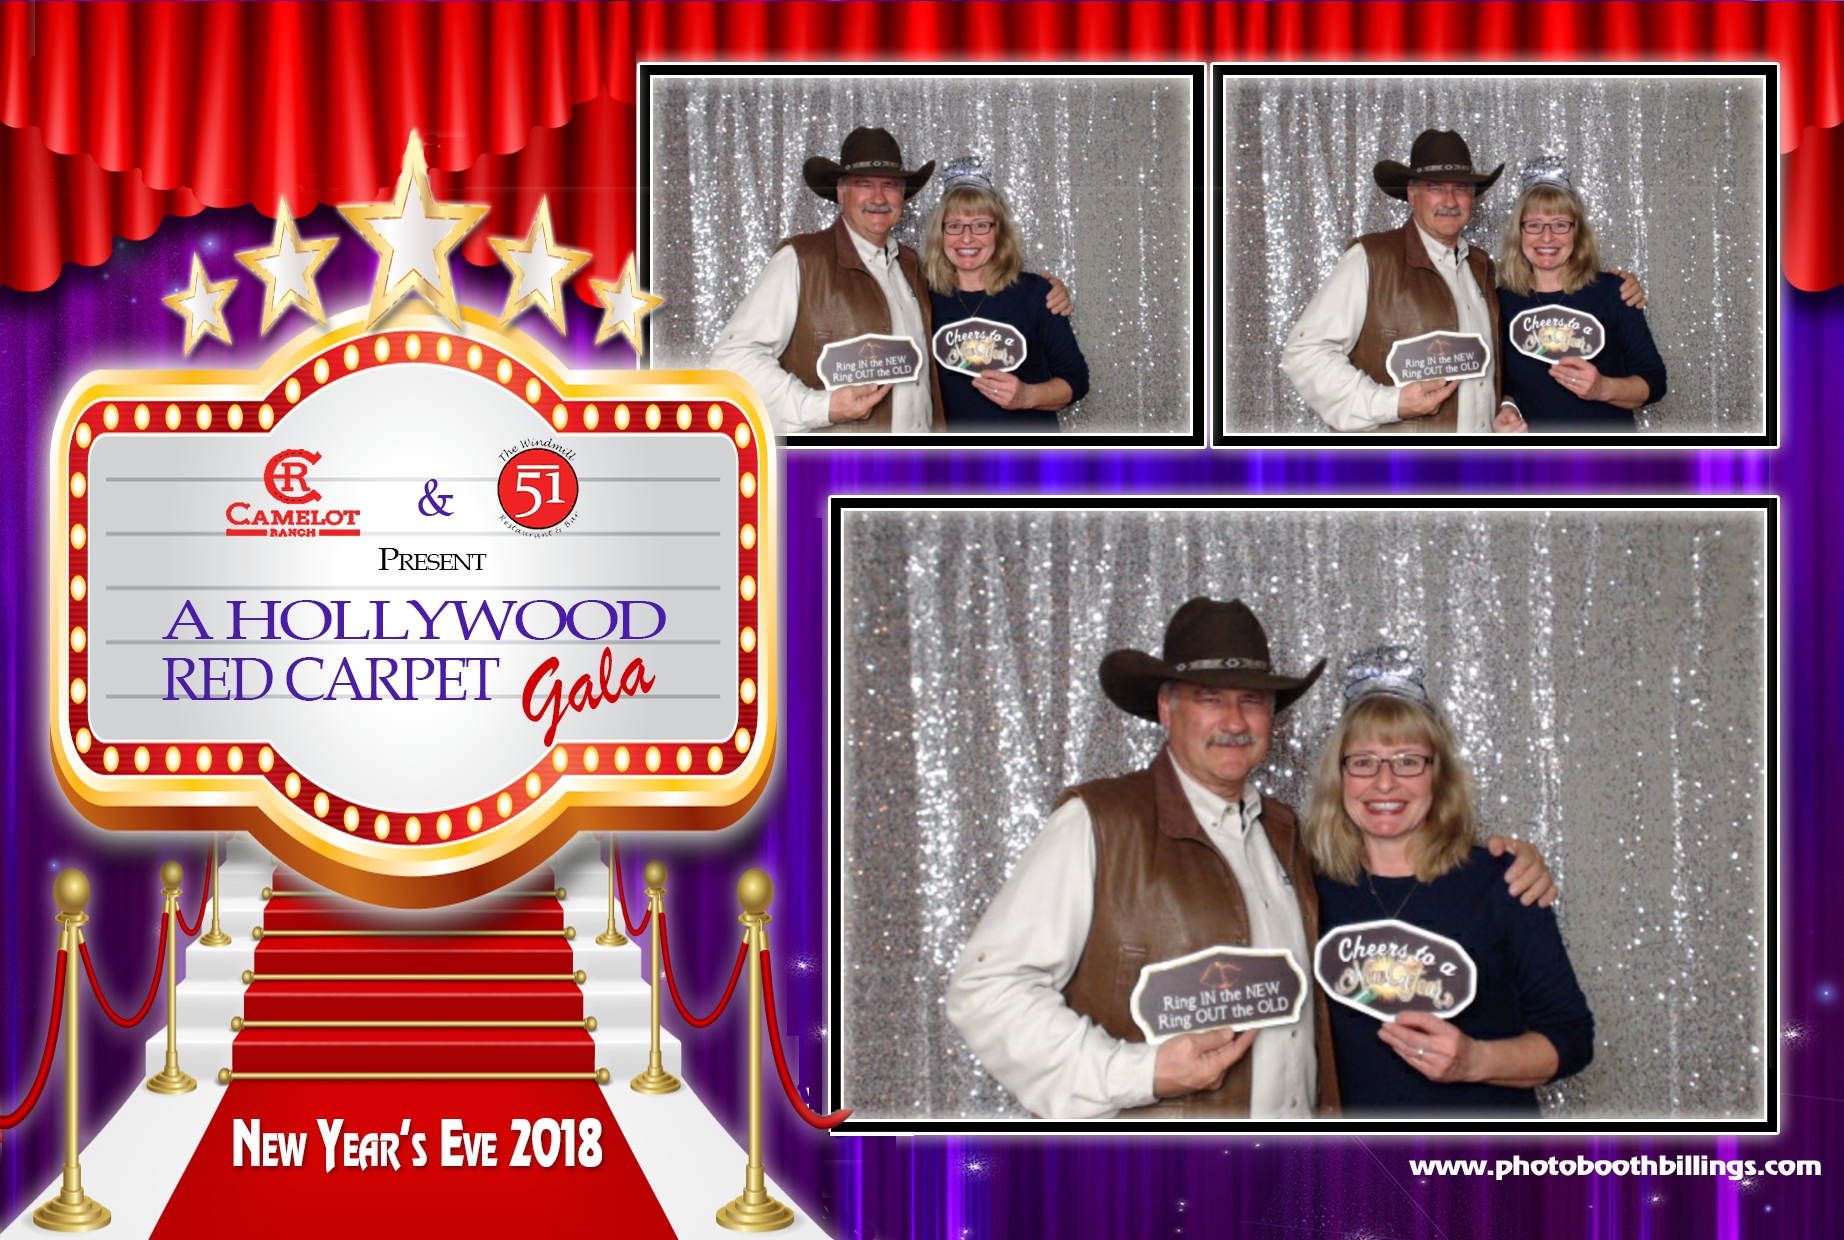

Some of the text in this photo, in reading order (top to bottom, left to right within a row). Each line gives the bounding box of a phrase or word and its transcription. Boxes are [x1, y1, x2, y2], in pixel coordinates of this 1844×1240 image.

[946, 329, 1014, 346] Cheers to a
[1523, 316, 1593, 335] Cheers to a
[833, 366, 911, 382] Ring OUT the OLD
[836, 356, 907, 371] Ring IN the NEW
[1402, 362, 1479, 379] Ring OUT the OLD
[1406, 353, 1474, 368] Ring IN the NEW
[498, 438, 576, 461] The Windmill
[418, 479, 454, 516] &
[515, 472, 565, 518] 51
[270, 529, 316, 537] RANCH
[498, 514, 552, 538] Restaurant
[565, 511, 578, 528] Bar
[162, 599, 666, 640] A HOLLYWOOD
[162, 646, 656, 747] RED CARPET Gala
[1338, 936, 1458, 976] Cheers to a
[1163, 982, 1280, 1012] Ring IN the NEW
[1158, 999, 1289, 1030] Ring OUT the OLD
[509, 1117, 602, 1168] 2018
